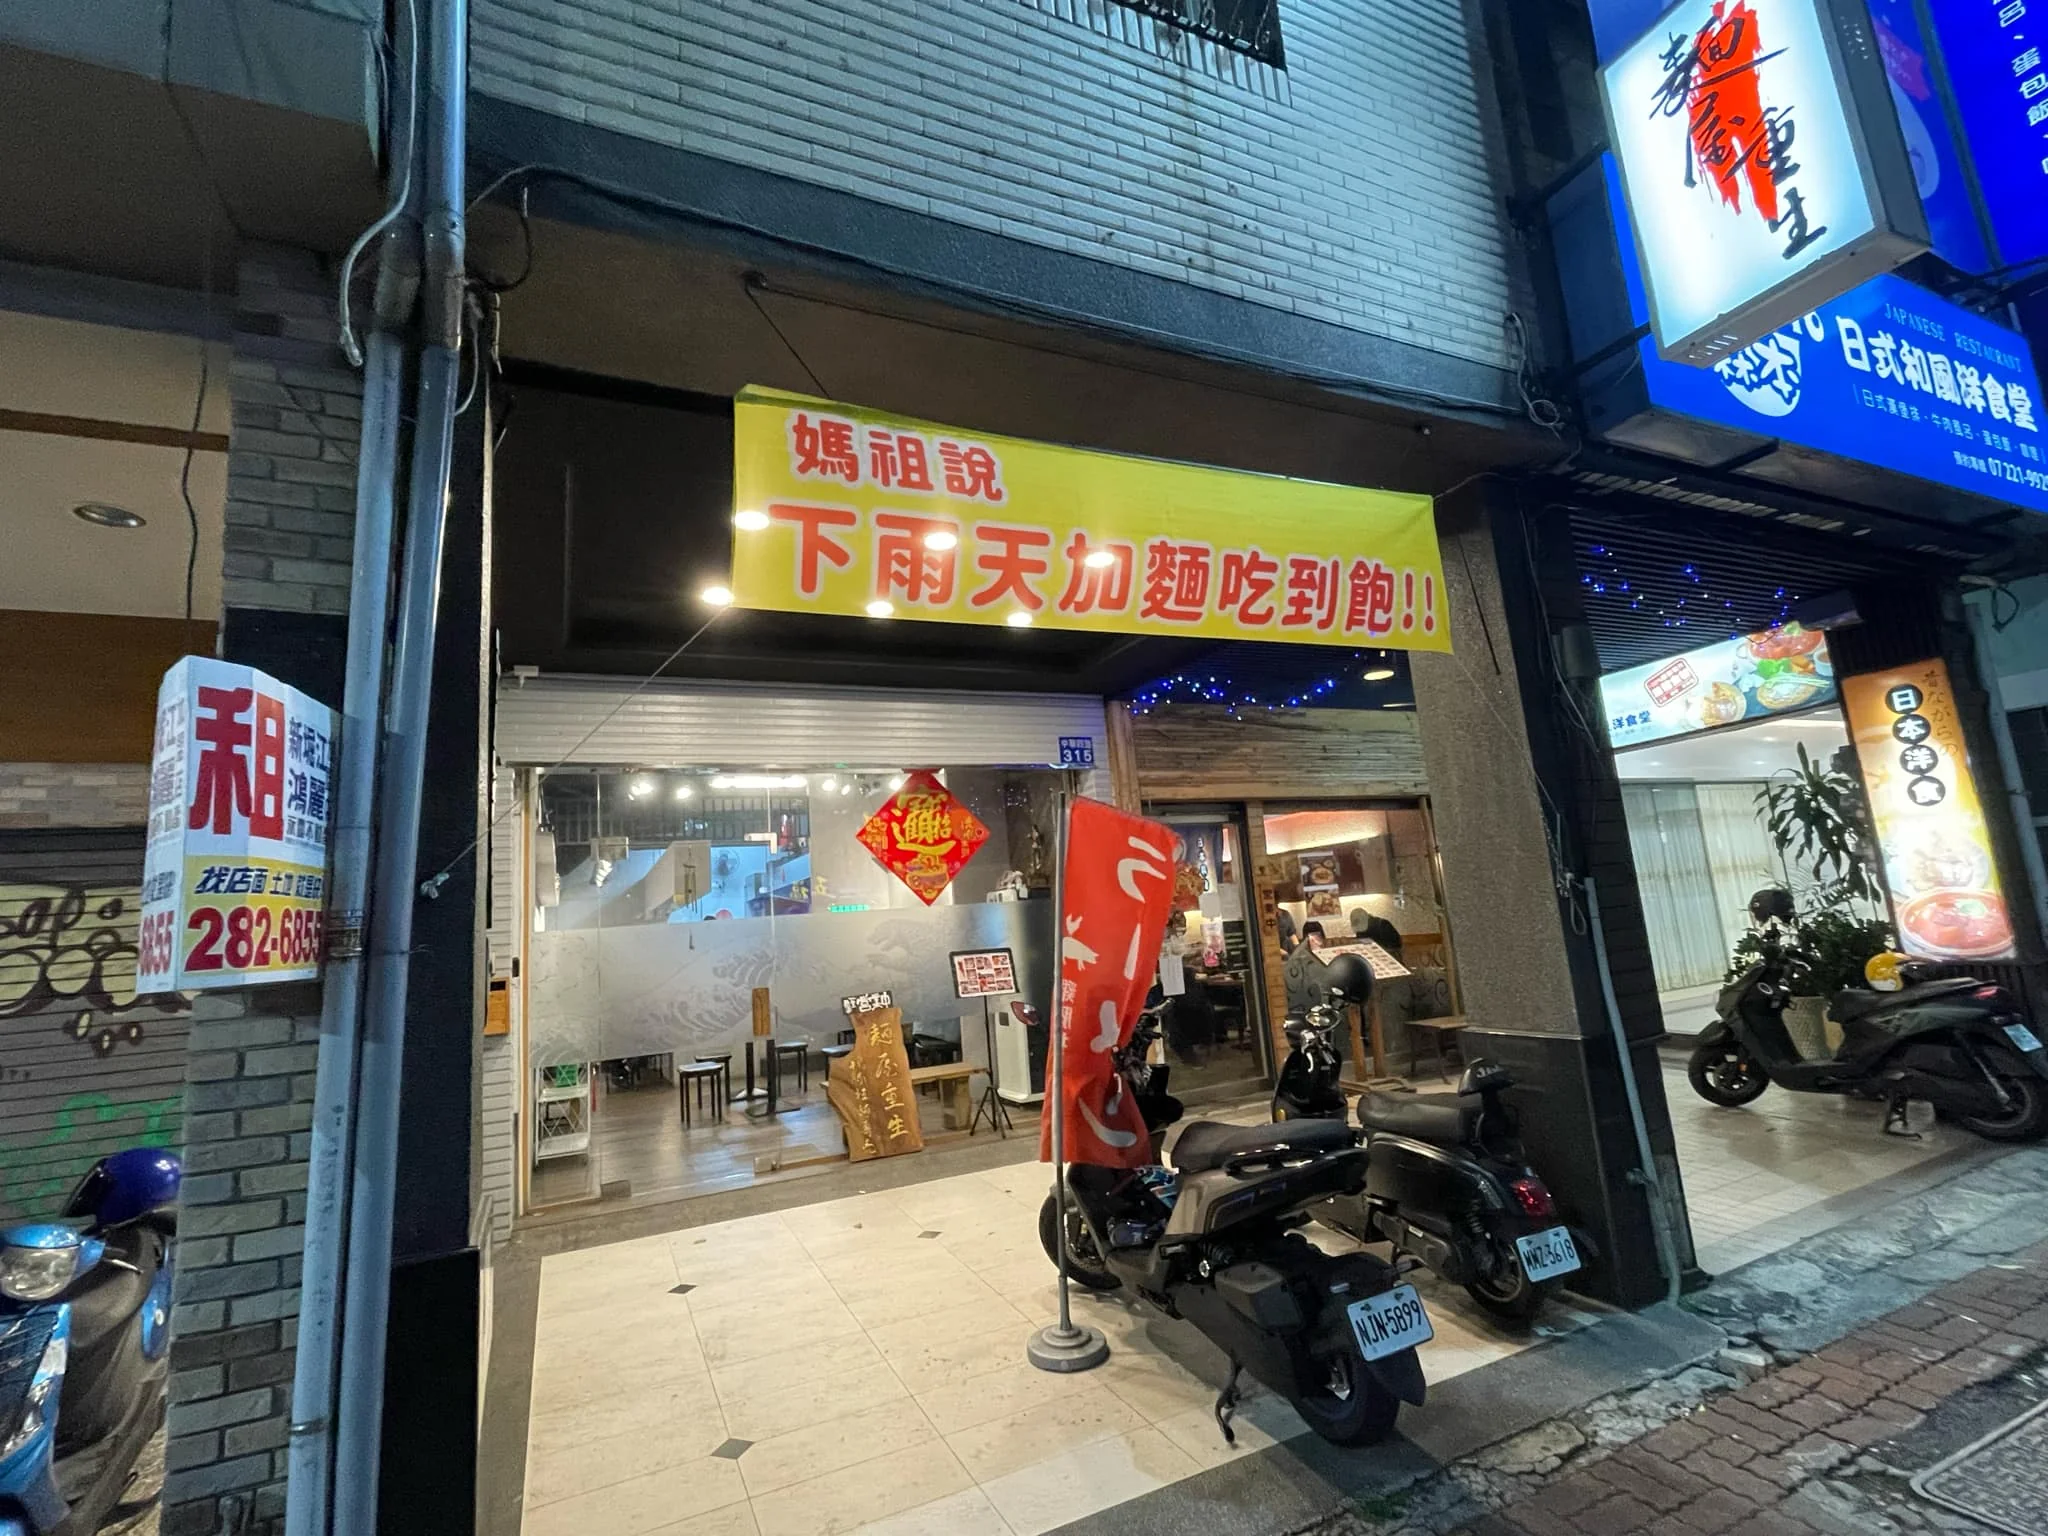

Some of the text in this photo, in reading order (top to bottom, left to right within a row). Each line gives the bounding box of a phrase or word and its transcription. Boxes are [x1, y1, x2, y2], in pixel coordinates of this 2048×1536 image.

[1835, 315, 2039, 433] 日式和風洋食堂
[793, 413, 1004, 502] 媽祖說
[768, 503, 1436, 634] 下雨天加麵吃到飽!!
[188, 685, 286, 841] 租
[1062, 749, 1093, 762] 315
[1886, 684, 1946, 806] 日本洋食
[193, 865, 268, 895] 找店面
[268, 871, 298, 897] 土地
[184, 905, 324, 973] 282-6855
[1355, 1299, 1422, 1348] NJN-5899
